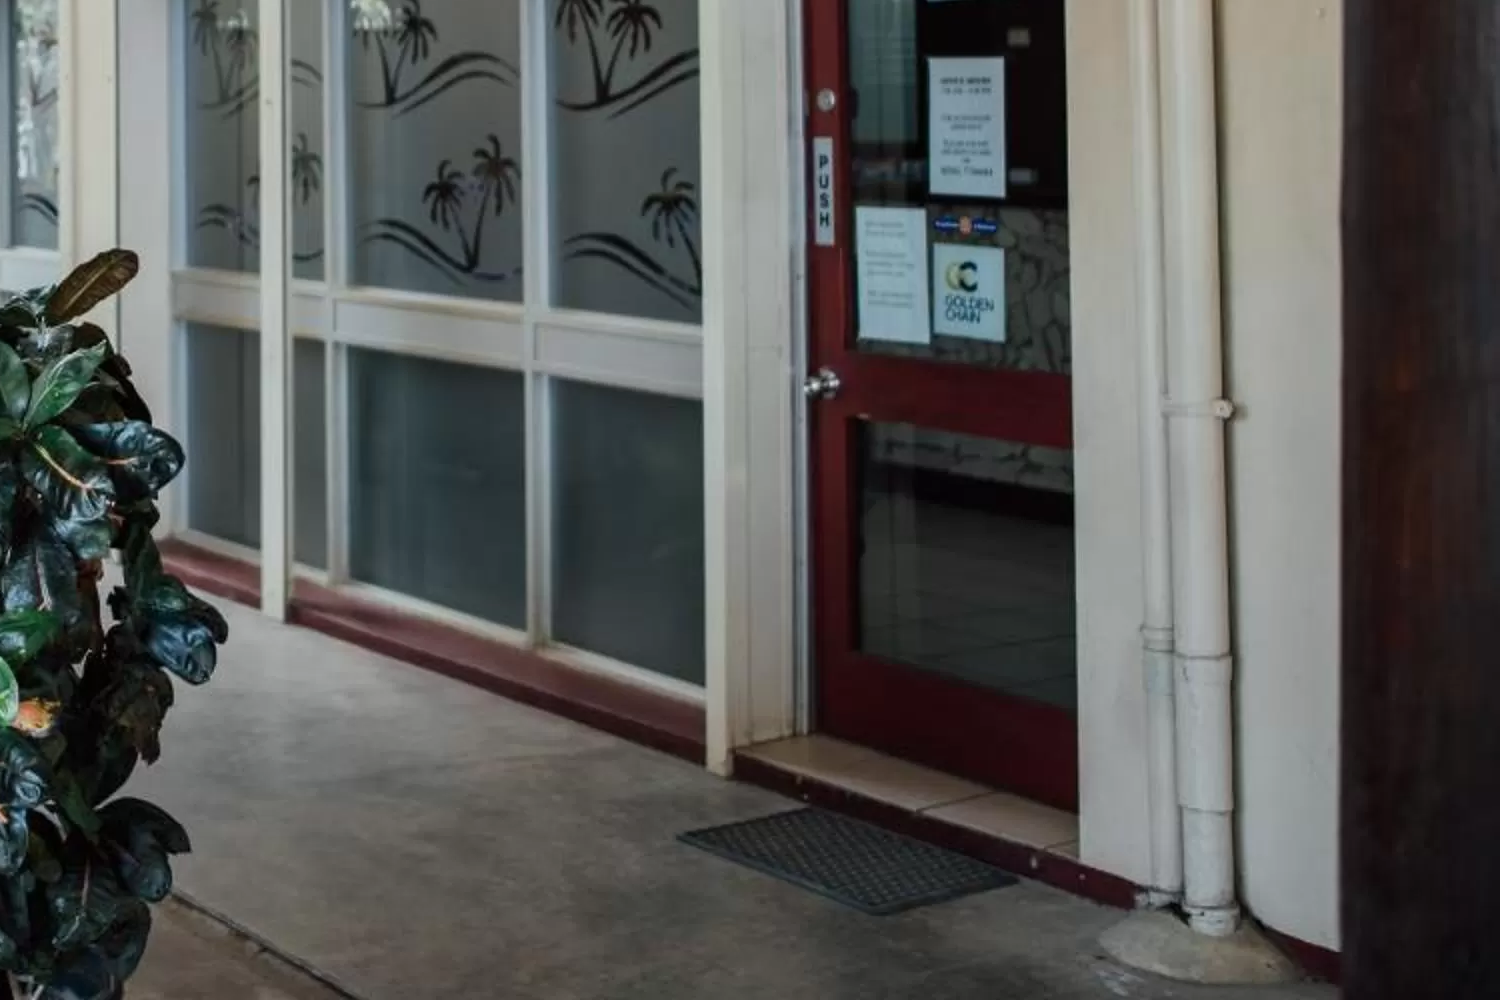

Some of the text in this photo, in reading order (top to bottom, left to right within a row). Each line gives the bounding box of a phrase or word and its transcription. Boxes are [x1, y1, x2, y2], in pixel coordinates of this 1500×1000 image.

[818, 154, 830, 227] PUSH
[945, 295, 995, 312] GOLDEN
[945, 308, 980, 324] CHAIN
